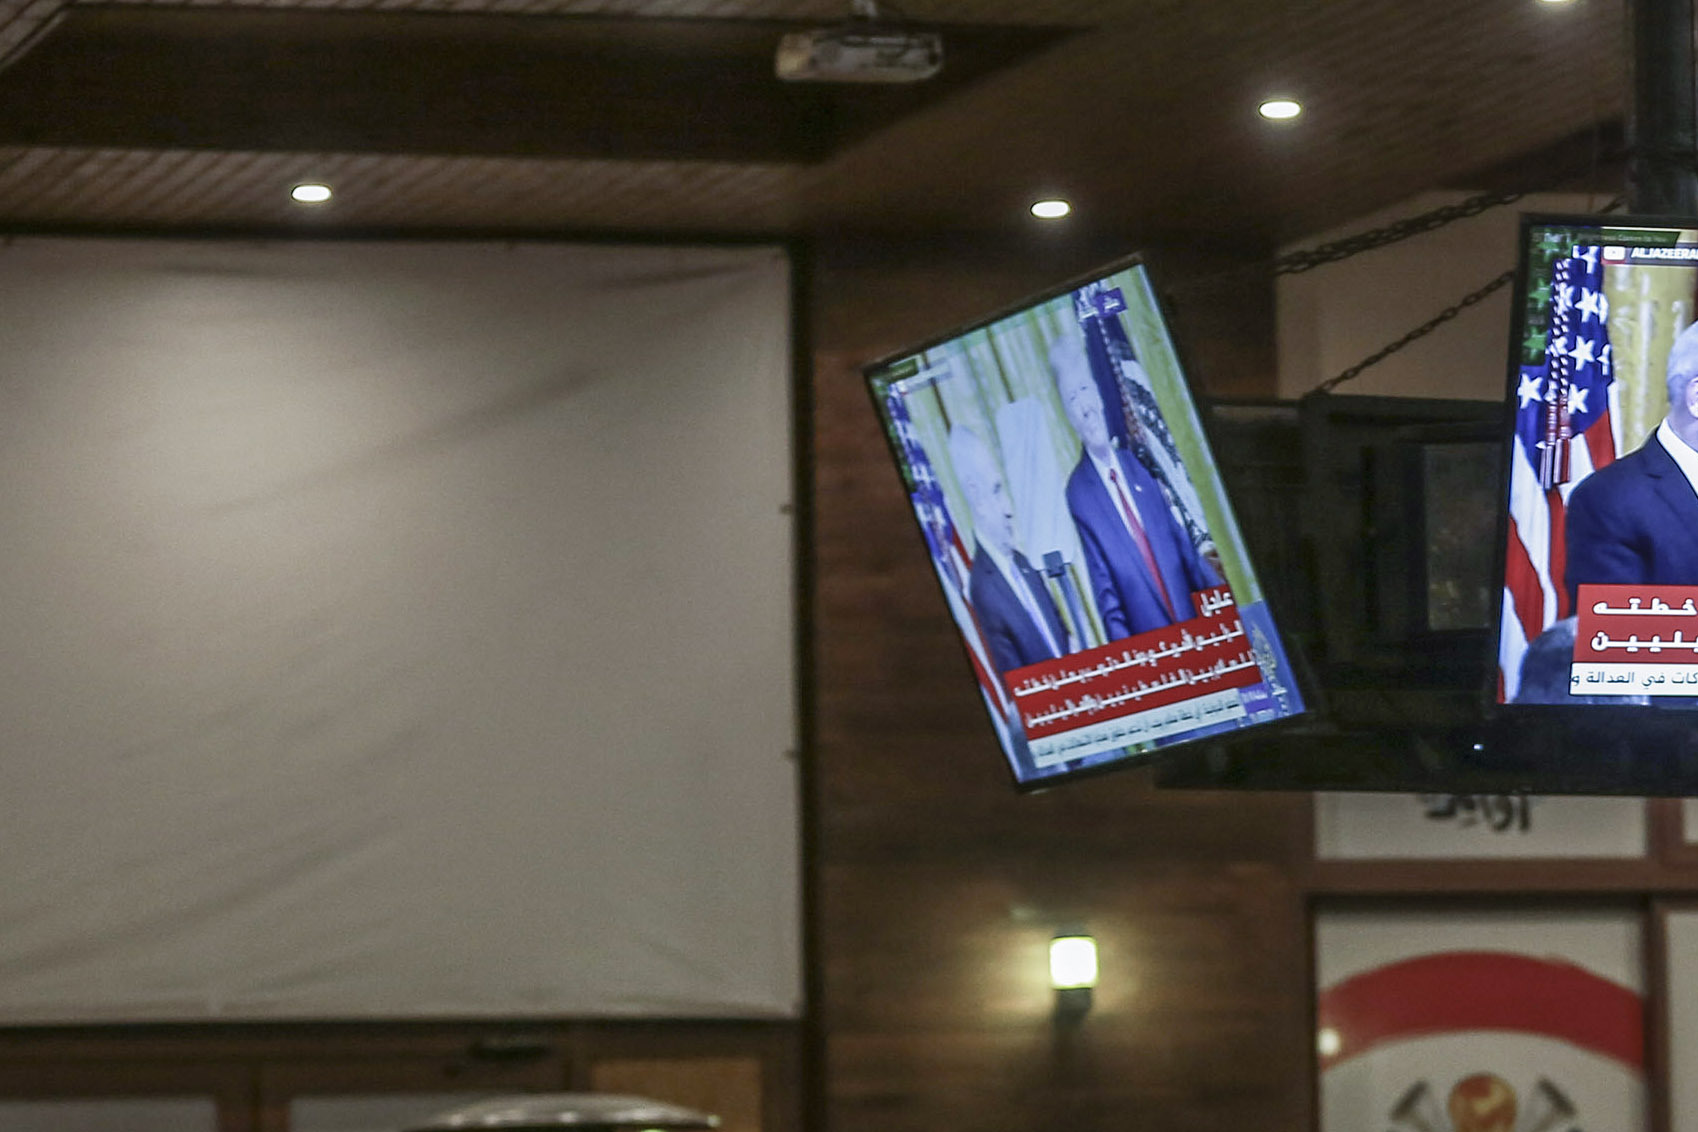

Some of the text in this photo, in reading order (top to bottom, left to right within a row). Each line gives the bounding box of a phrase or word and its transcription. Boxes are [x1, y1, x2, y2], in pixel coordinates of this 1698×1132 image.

[1592, 597, 1697, 617] خطته
[1585, 671, 1635, 685] العدالة
[1640, 672, 1665, 690] في
